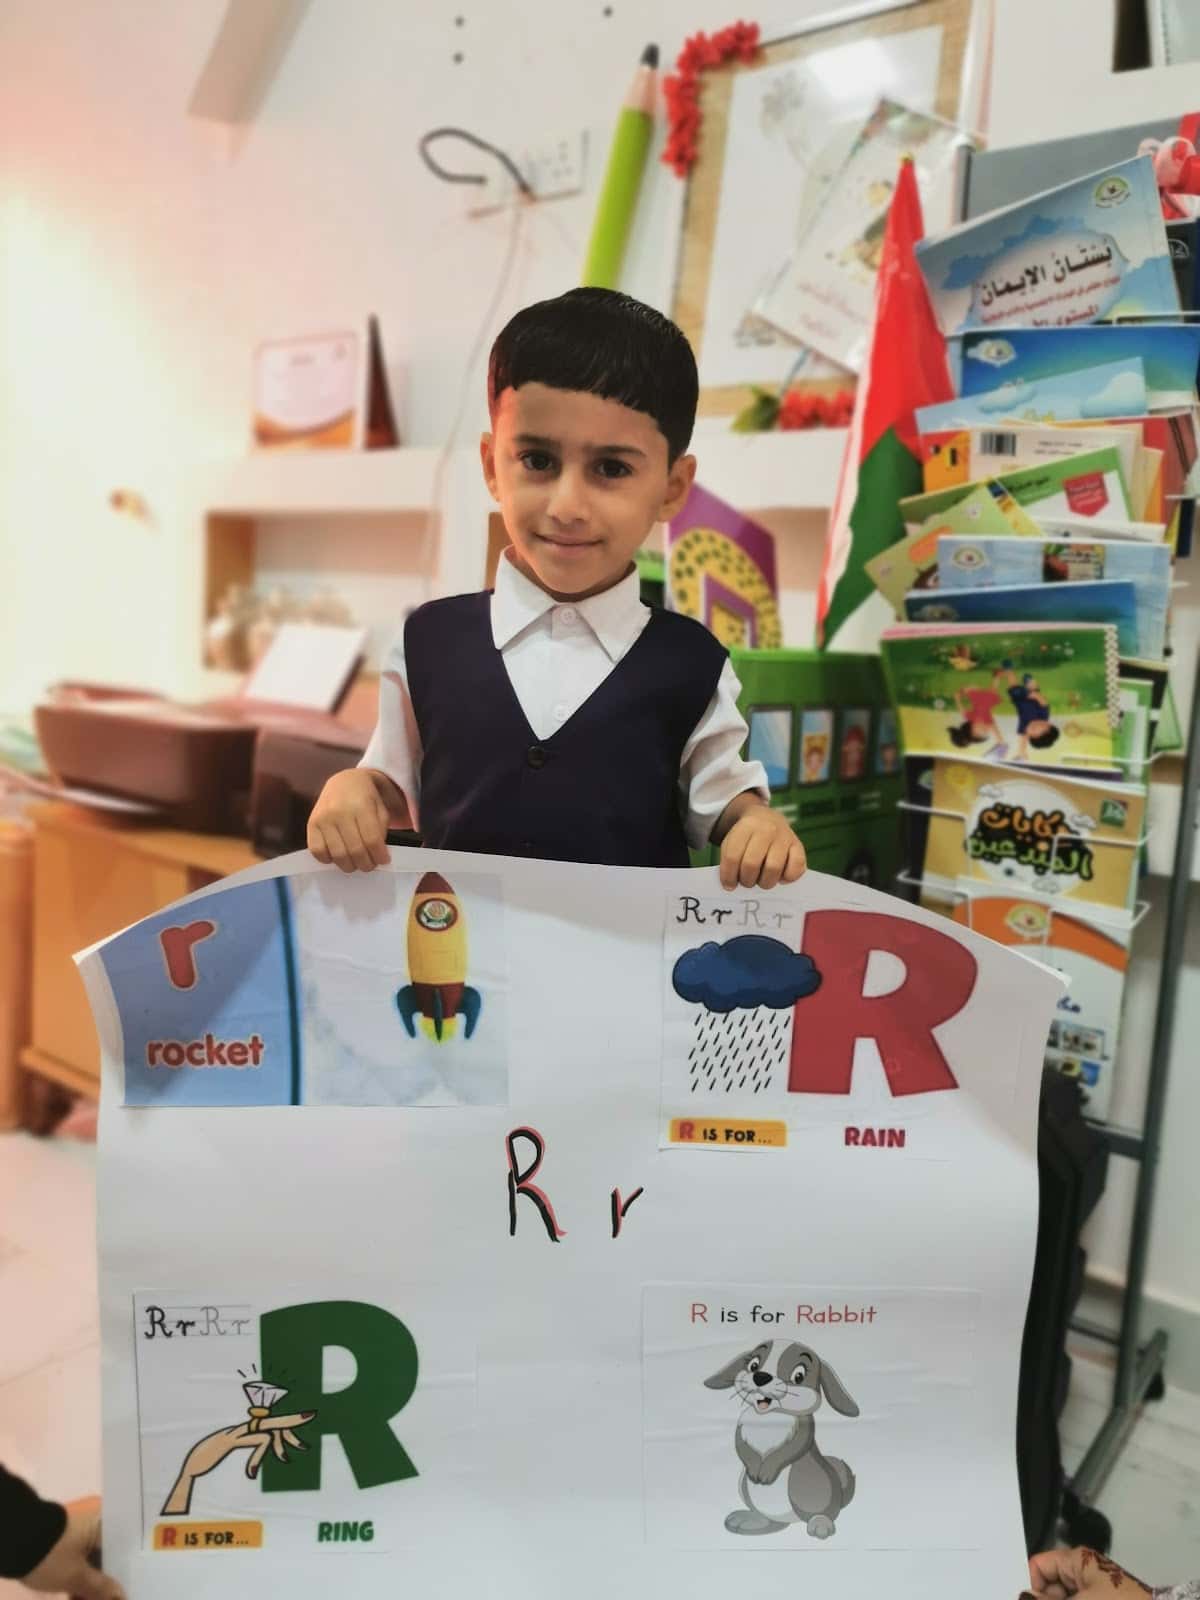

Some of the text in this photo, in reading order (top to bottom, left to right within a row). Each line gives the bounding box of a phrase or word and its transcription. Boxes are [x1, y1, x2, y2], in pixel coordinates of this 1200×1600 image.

[159, 920, 216, 990] r
[787, 909, 978, 1097] R
[146, 1034, 265, 1069] rocket
[679, 1121, 695, 1140] R
[703, 1129, 717, 1141] IS
[844, 1126, 906, 1148] RAIN
[506, 1126, 644, 1243] R r
[690, 1303, 877, 1324] R is for Rabbit
[260, 1300, 419, 1493] R
[162, 1527, 176, 1547] R
[184, 1533, 198, 1545] IS
[317, 1521, 374, 1542] RING
